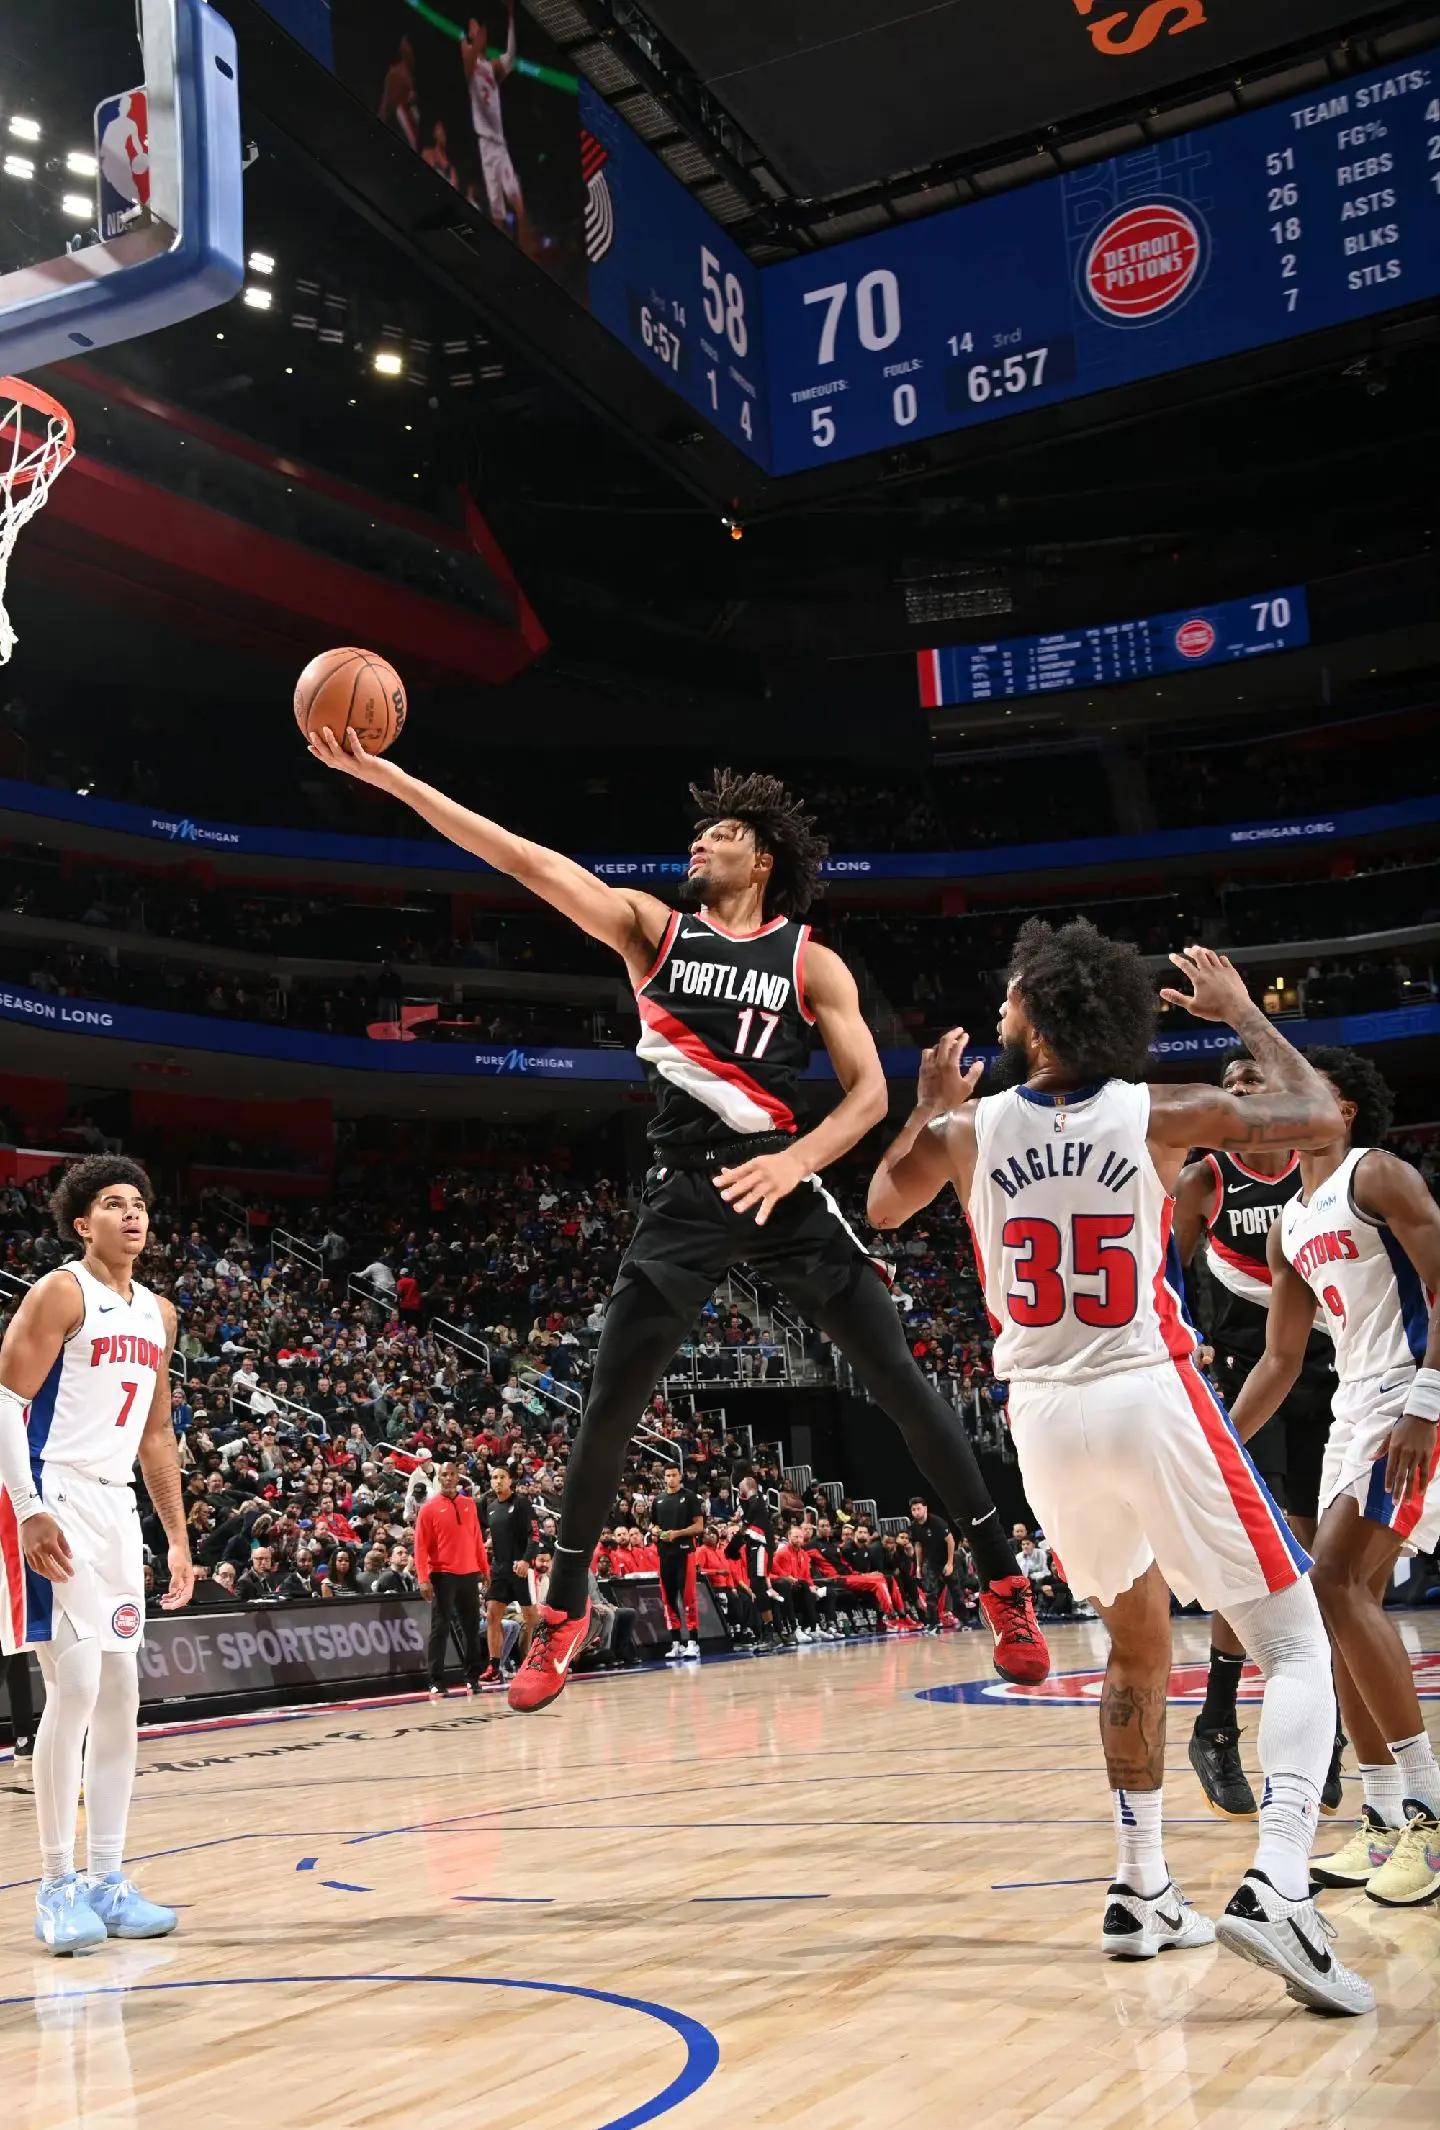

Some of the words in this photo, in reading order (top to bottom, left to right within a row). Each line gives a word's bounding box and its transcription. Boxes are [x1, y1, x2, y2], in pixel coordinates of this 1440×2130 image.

[1290, 95, 1349, 130] TEAM
[1355, 69, 1431, 109] STATS:
[1266, 147, 1294, 176] 51
[1337, 119, 1388, 150] FG%
[1267, 182, 1298, 212] 26
[1336, 152, 1393, 187] REBS
[106, 207, 133, 236] NB
[1270, 216, 1300, 244] 18
[1340, 188, 1396, 222] ASTS
[1103, 231, 1180, 270] DETROIT
[1281, 253, 1297, 278] 2
[1344, 223, 1399, 256] BLKS
[1105, 253, 1183, 292] PISTONS
[1283, 288, 1299, 312] 7
[1349, 258, 1401, 290] STLS
[701, 245, 748, 358] 58
[803, 269, 901, 365] 70
[641, 306, 680, 371] 6:57
[947, 332, 974, 356] 14
[992, 328, 1022, 348] 3rd
[707, 369, 718, 410] 1
[883, 358, 924, 379] FOULS:
[967, 347, 1049, 402] 6:57
[791, 379, 849, 403] TIMEOUTS:
[893, 383, 918, 426] 0
[740, 401, 753, 441] 4
[811, 406, 835, 447] 5
[1251, 598, 1291, 631] 70
[152, 820, 178, 833] PURE
[1231, 822, 1335, 841] MICHIGAN.ORG
[595, 863, 637, 874] KEEP
[642, 863, 657, 873] IT
[827, 861, 871, 871] LONG
[669, 959, 790, 1012] PORTLAND
[61, 1008, 113, 1026] LONG
[733, 1007, 780, 1060] 17
[475, 1055, 505, 1066] PURE
[496, 1049, 573, 1074] MICHIGAN
[991, 1142, 1093, 1199] BAGLEY
[1097, 1150, 1139, 1193] III
[1226, 1205, 1283, 1237] PORT
[1002, 1213, 1139, 1328] 35
[1322, 1285, 1347, 1332] 9
[115, 1381, 138, 1427] 7
[138, 1645, 169, 1679] G
[173, 1635, 212, 1674] OF
[216, 1616, 425, 1670] SPORTSBOOKS
